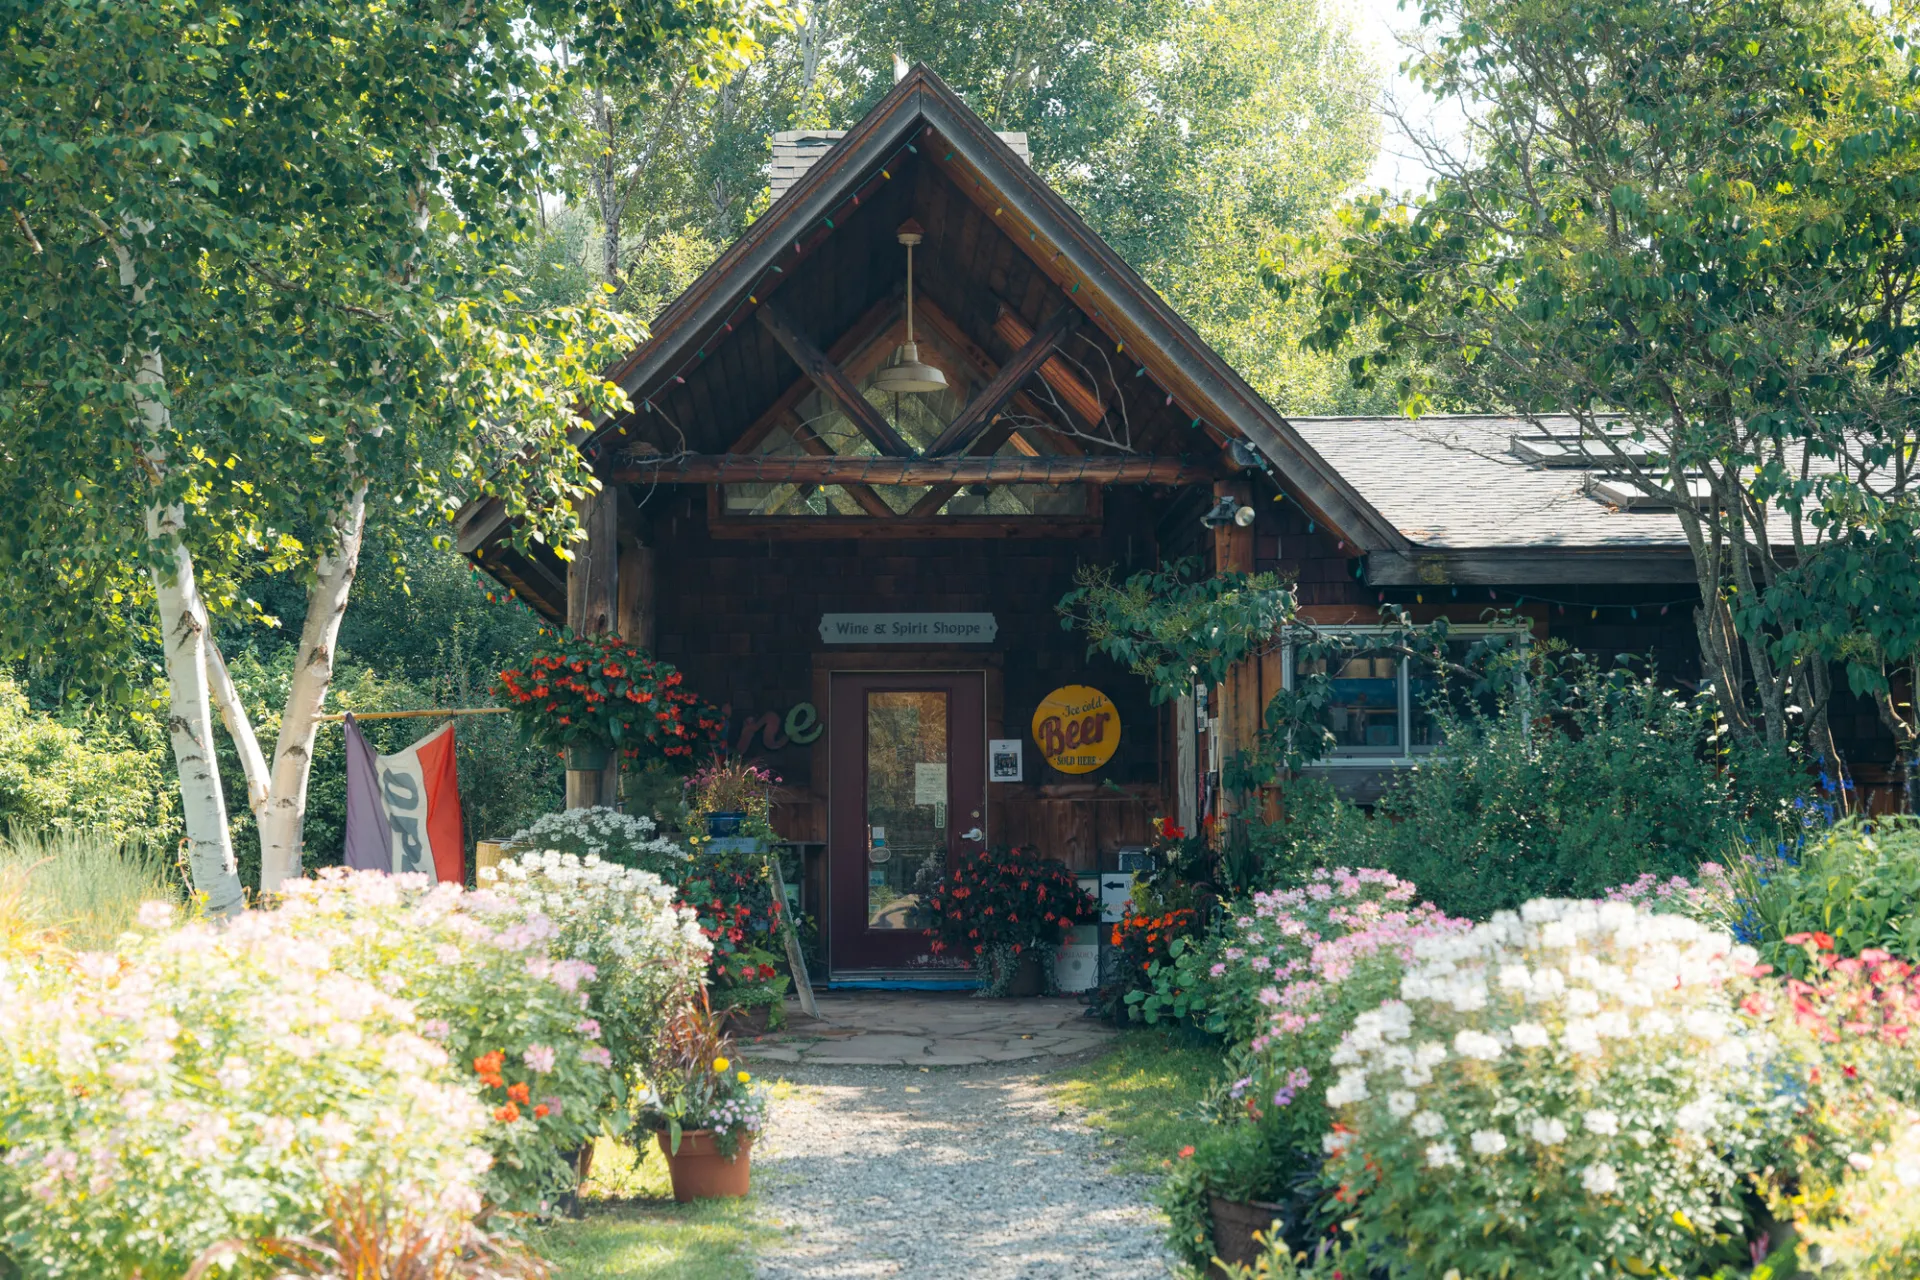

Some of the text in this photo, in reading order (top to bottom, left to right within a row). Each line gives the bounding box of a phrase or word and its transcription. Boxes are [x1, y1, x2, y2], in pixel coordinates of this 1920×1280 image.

[836, 621, 981, 637] Wine & Spirit Shoppe
[1063, 696, 1102, 718] Ice cold
[1038, 712, 1111, 758] Beer
[1057, 756, 1097, 766] SOLD HERE
